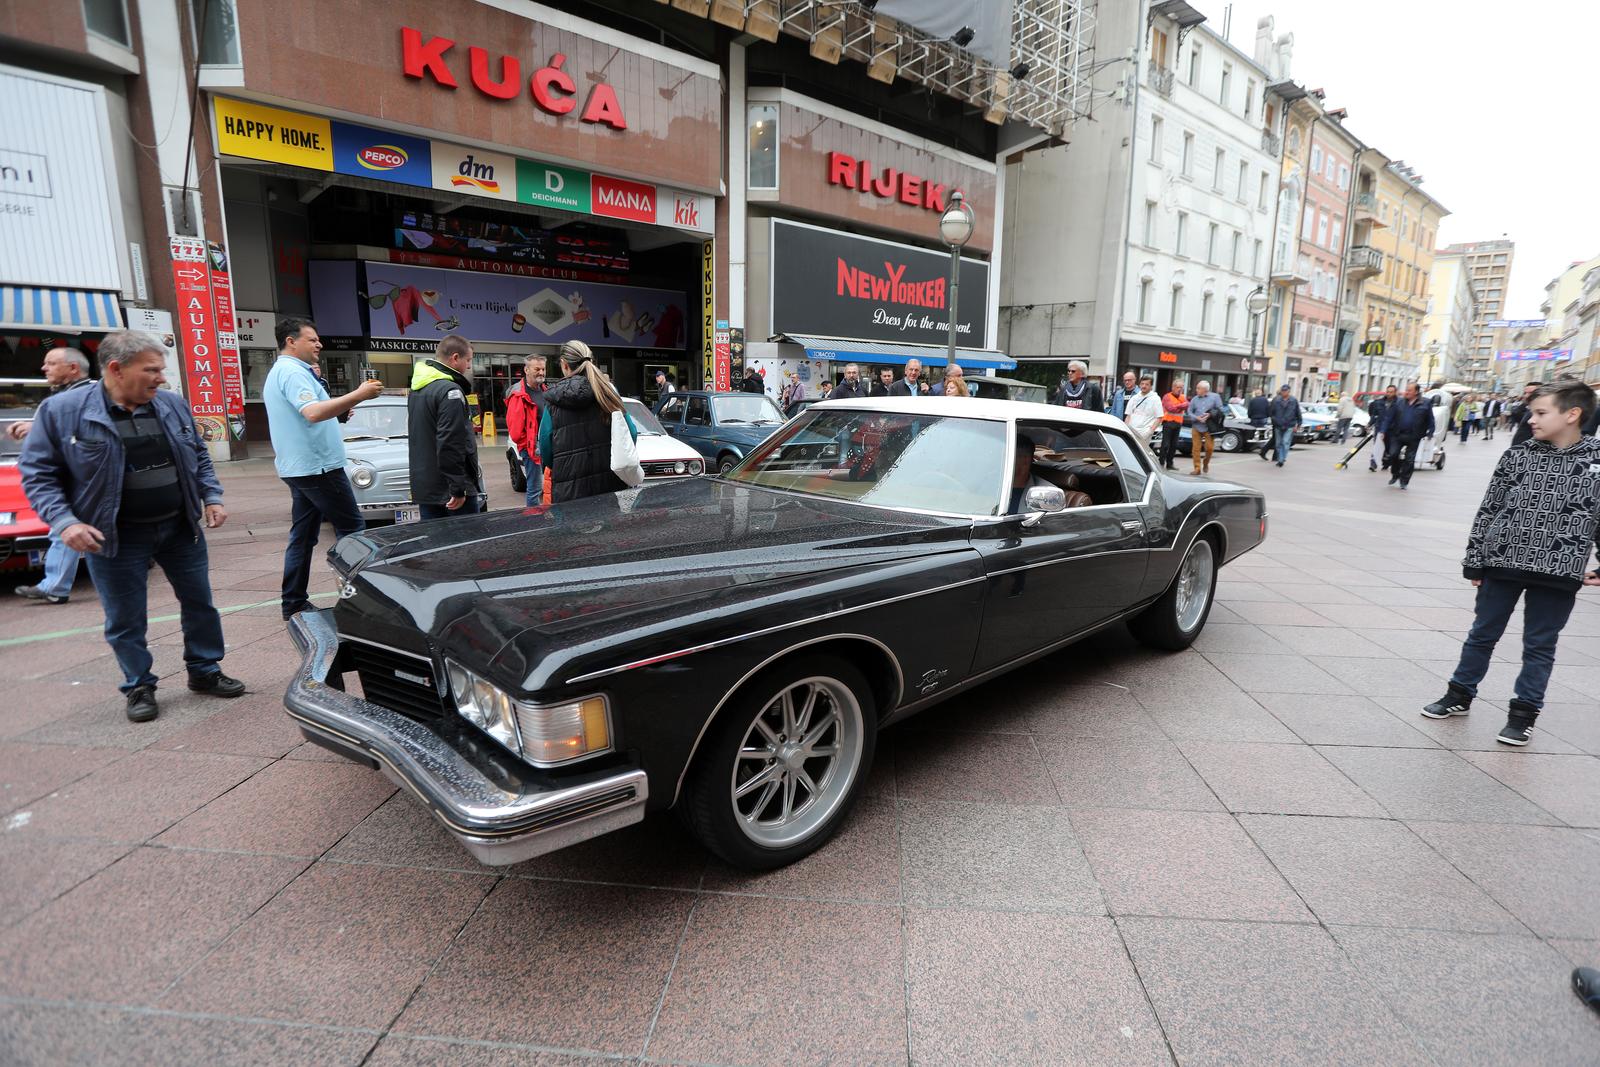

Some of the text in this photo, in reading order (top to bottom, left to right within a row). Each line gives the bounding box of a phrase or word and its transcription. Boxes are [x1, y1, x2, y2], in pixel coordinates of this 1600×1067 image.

[400, 26, 627, 130] KUĆA
[225, 116, 325, 151] HAPPY HOME.
[365, 150, 402, 166] PEPCO
[459, 155, 494, 181] dm
[545, 170, 564, 193] D
[532, 192, 578, 207] DEICHMANN
[598, 186, 652, 212] MANA
[675, 196, 699, 227] kik
[172, 245, 204, 256] 777
[458, 259, 579, 279] AUTOMAT CLUB
[449, 299, 458, 309] U
[485, 301, 517, 314] Rijeke
[704, 243, 712, 379] OTKUP ZLATA
[872, 308, 901, 326] Dress
[900, 313, 918, 331] for
[920, 315, 934, 330] the
[188, 297, 213, 402] AUTOMAT
[370, 341, 418, 351] MASKICE
[193, 404, 224, 413] CLUB
[402, 511, 413, 521] RI
